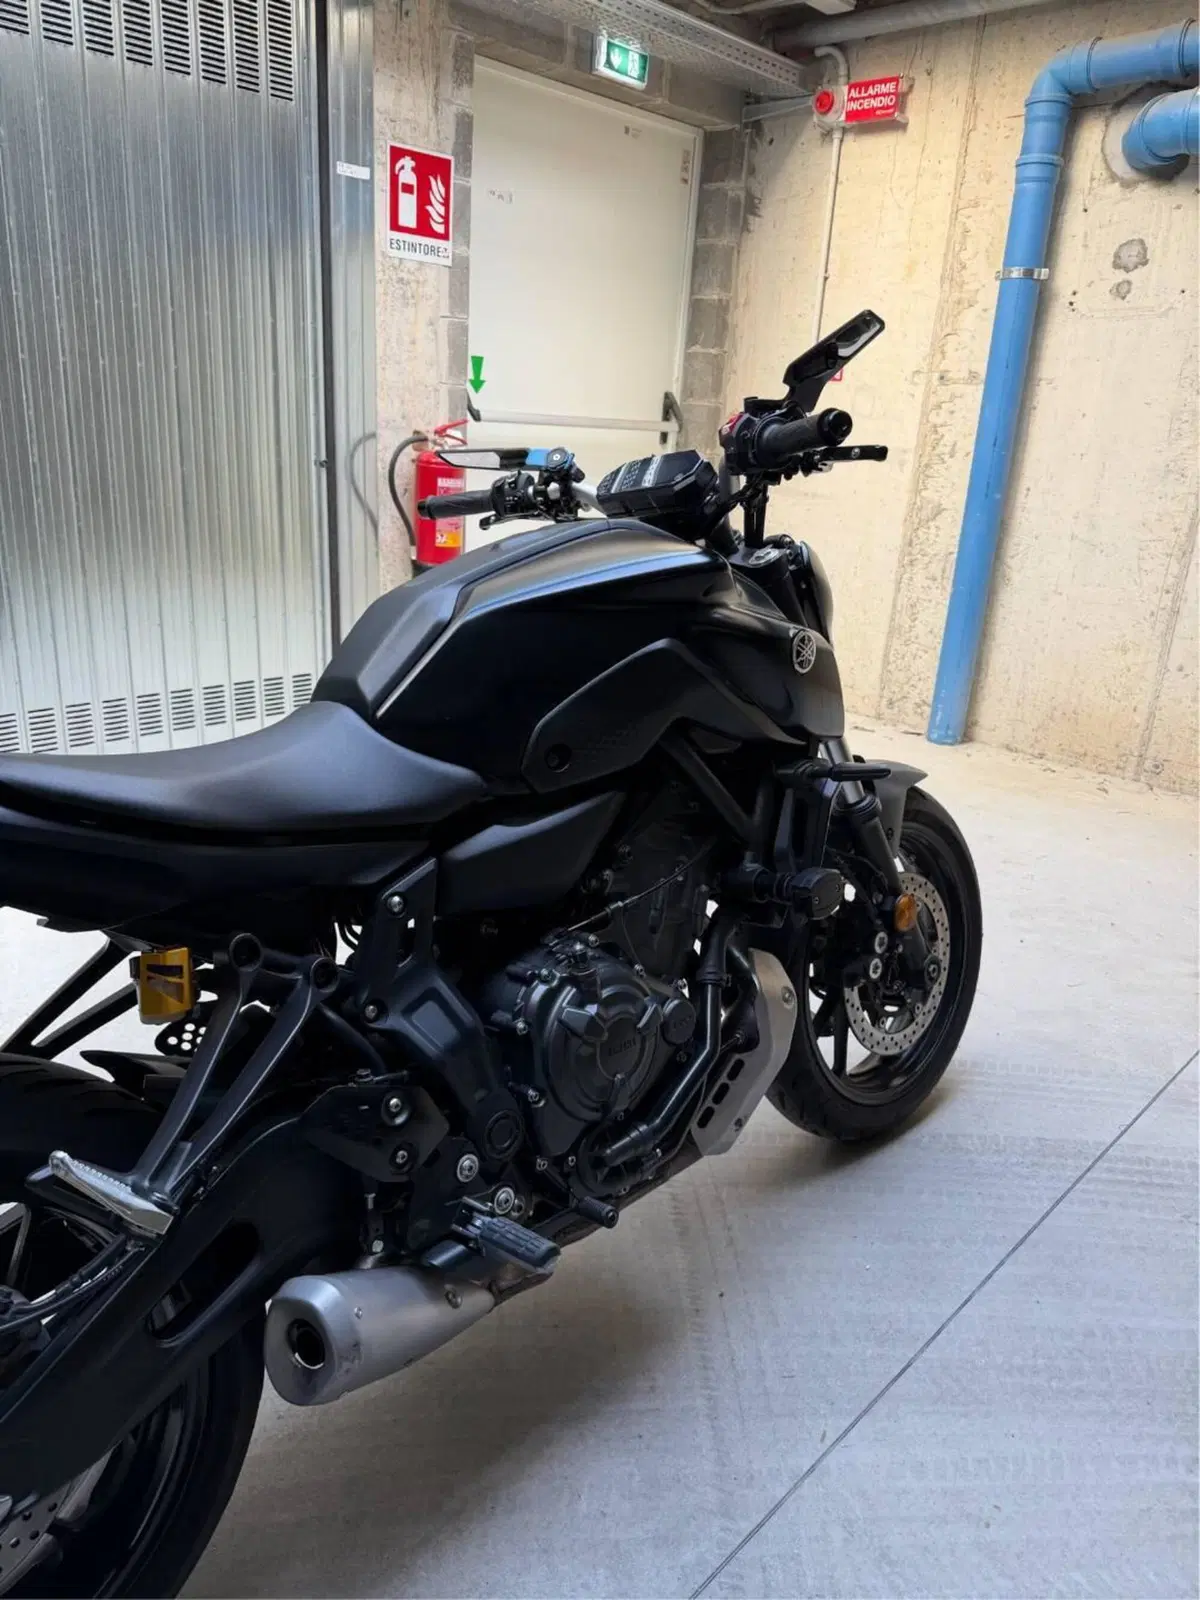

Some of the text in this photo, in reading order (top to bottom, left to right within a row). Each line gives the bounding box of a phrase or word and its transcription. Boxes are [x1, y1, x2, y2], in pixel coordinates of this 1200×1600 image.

[848, 82, 897, 99] ALLARME
[847, 95, 896, 112] INCENDIO
[389, 238, 442, 259] ESTINTORE
